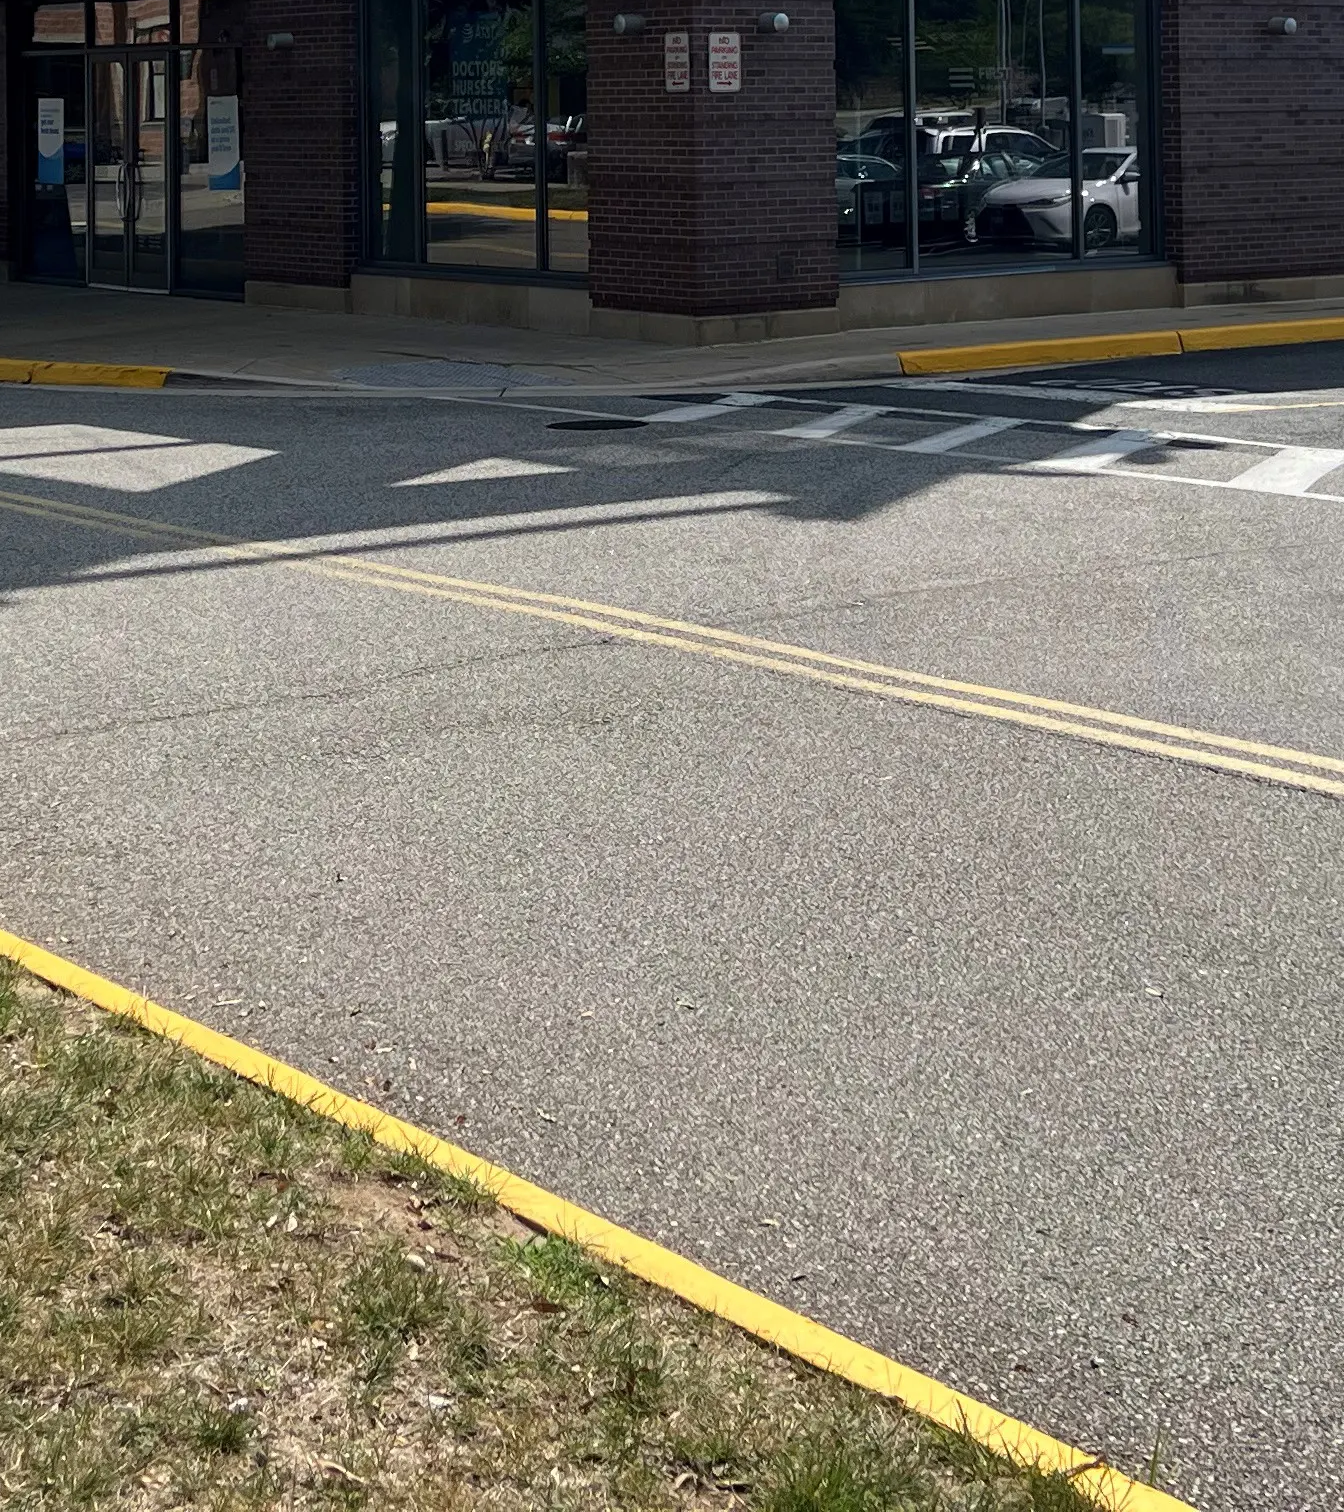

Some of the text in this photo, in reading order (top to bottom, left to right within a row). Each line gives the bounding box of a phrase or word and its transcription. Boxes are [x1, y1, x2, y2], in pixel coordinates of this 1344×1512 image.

[711, 46, 738, 54] PARKING
[452, 59, 504, 77] DOCTORS
[711, 70, 739, 80] FIRE LANE
[452, 78, 495, 96] NURSES
[452, 97, 508, 116] TEACHERS
